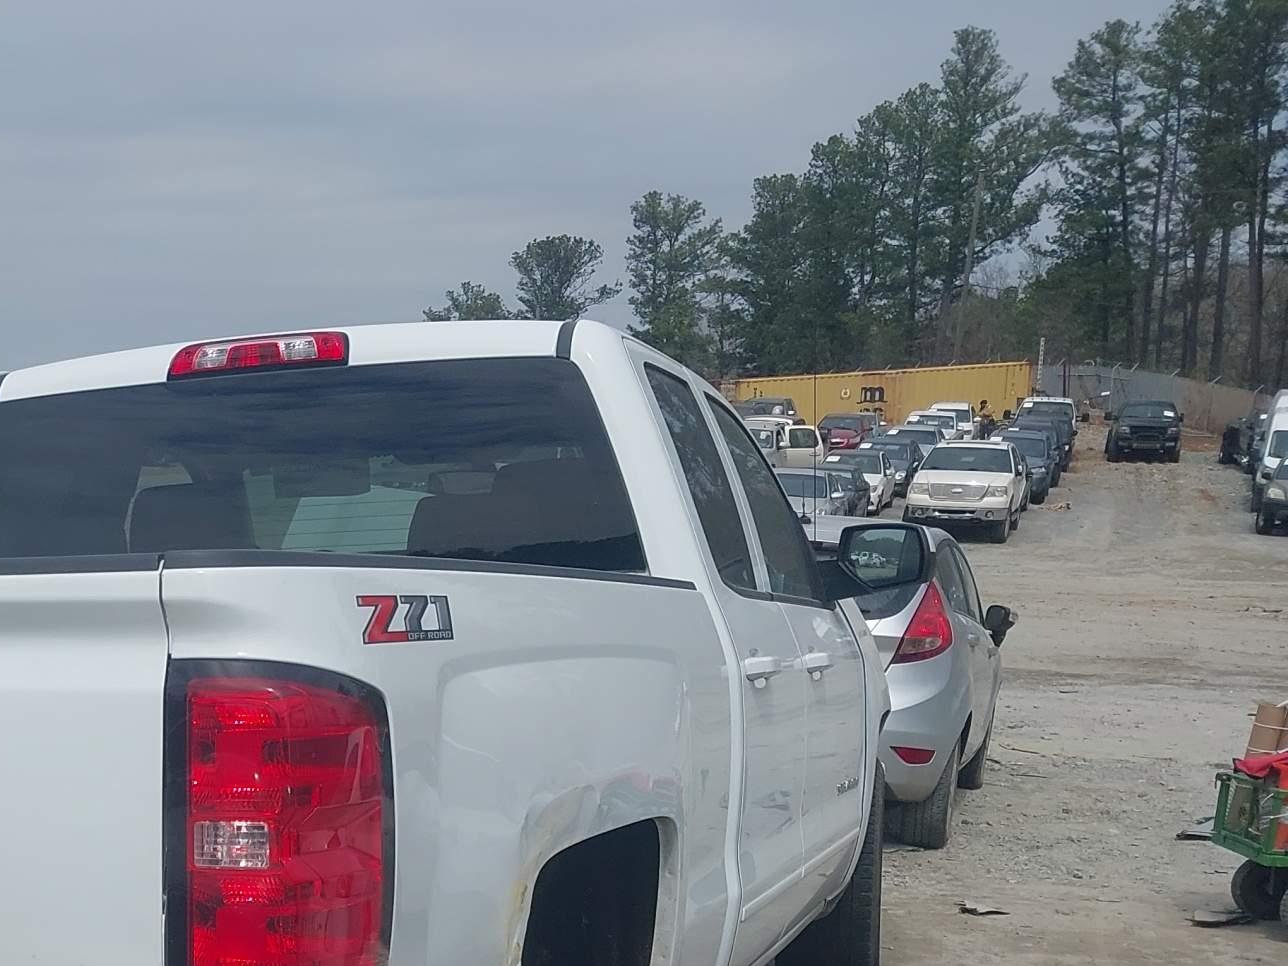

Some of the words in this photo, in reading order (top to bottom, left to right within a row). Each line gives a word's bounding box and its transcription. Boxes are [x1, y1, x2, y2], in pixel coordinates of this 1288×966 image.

[356, 595, 454, 644] Z71
[407, 632, 426, 640] OFF
[427, 631, 452, 640] ROAD
